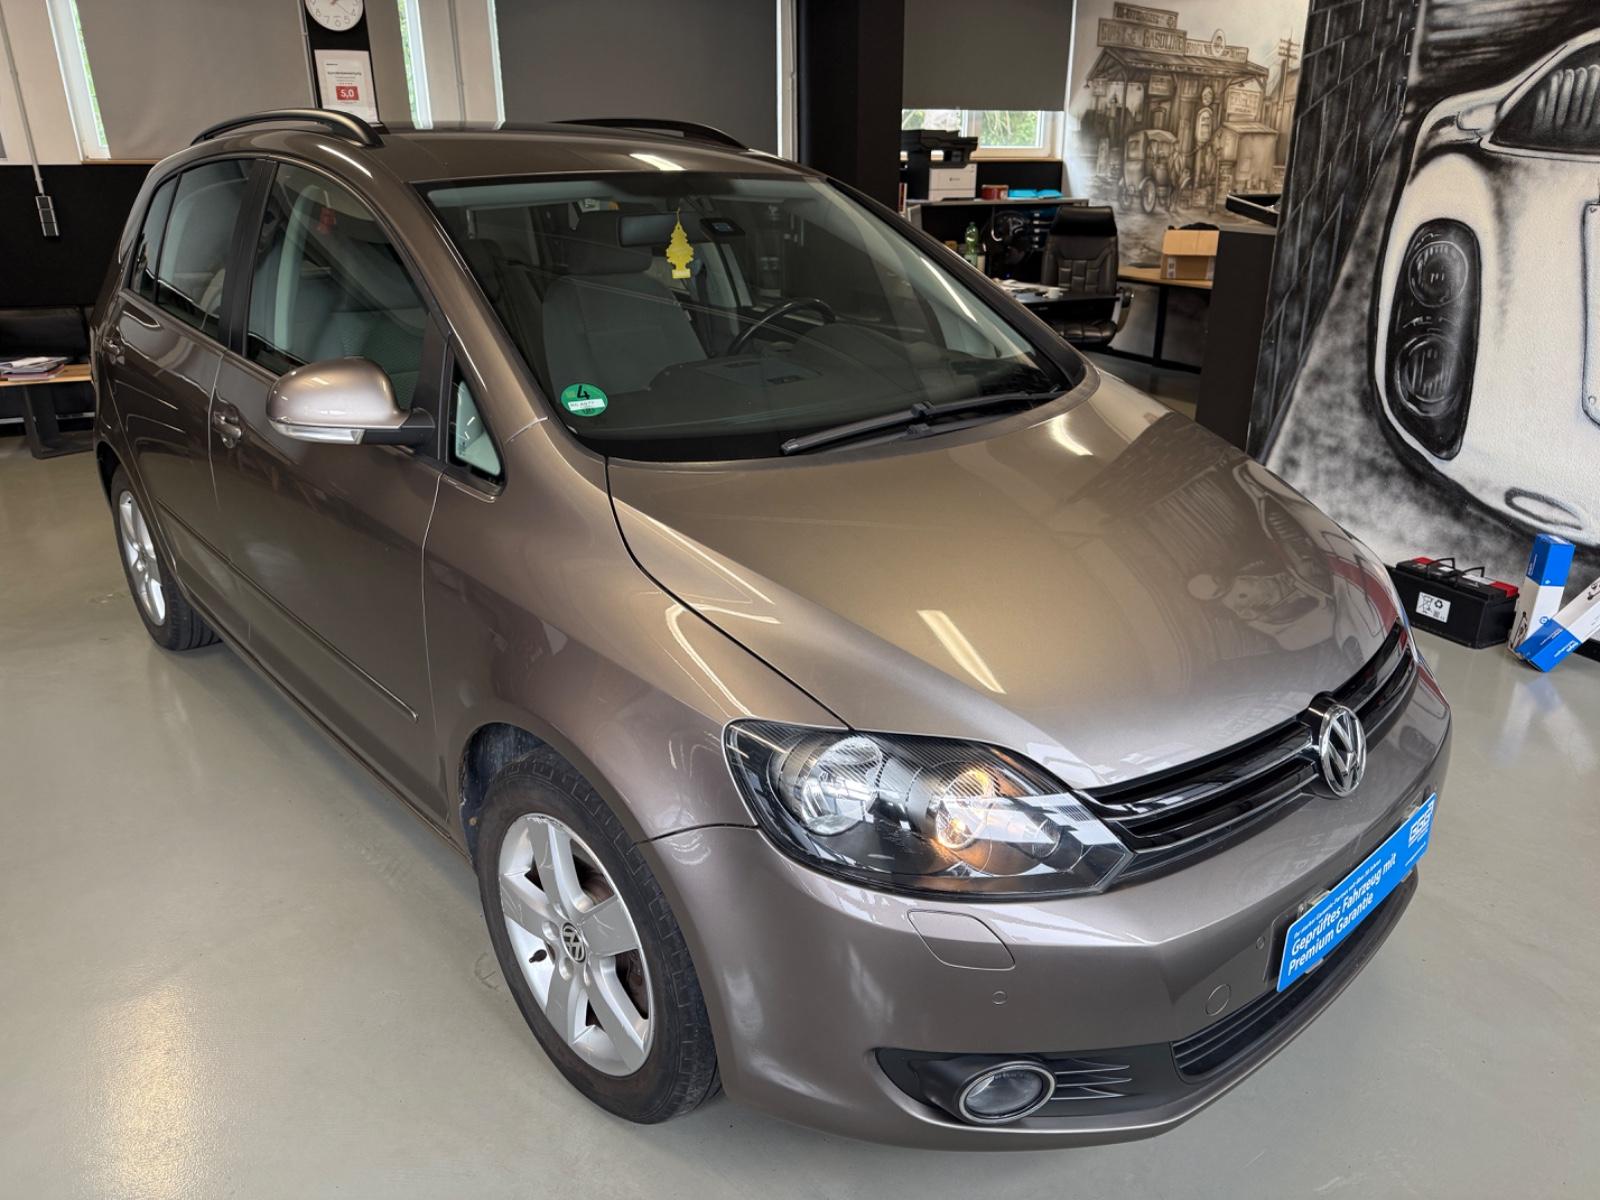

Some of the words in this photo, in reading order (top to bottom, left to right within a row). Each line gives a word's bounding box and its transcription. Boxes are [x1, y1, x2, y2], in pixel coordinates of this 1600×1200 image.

[340, 89, 354, 98] 5,0
[577, 385, 590, 399] 4
[1291, 906, 1341, 956] Geprüftes
[1342, 868, 1382, 913] Fahrzeug
[1382, 852, 1397, 875] mit
[1288, 929, 1334, 976] Premium
[1336, 893, 1374, 934] Garantie
